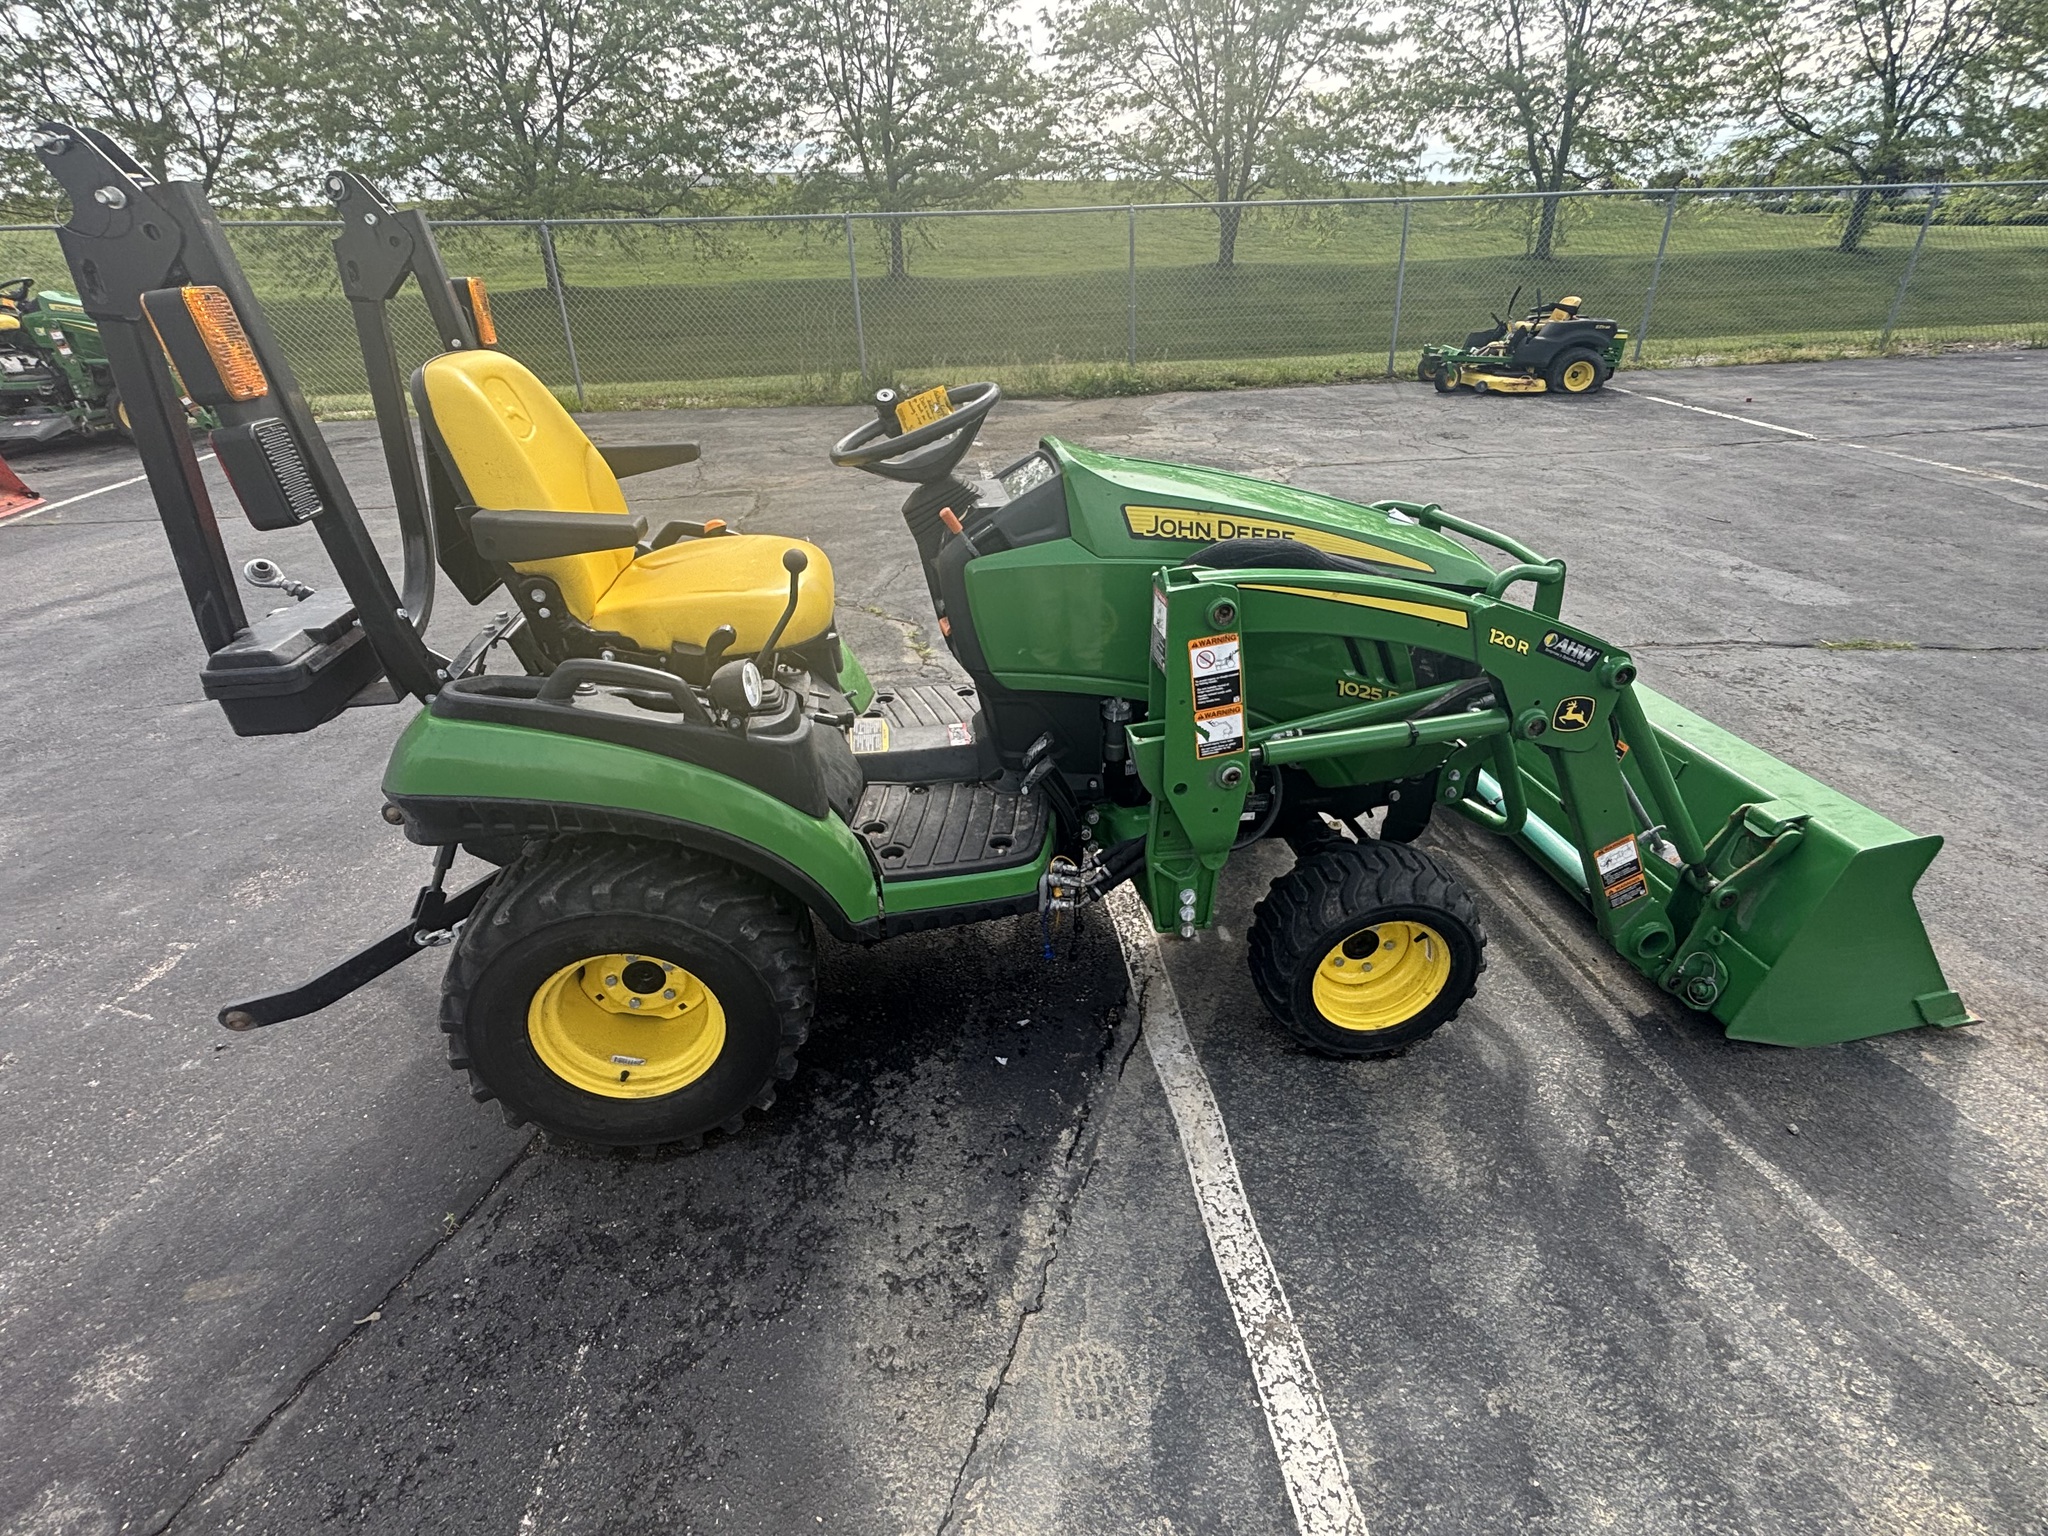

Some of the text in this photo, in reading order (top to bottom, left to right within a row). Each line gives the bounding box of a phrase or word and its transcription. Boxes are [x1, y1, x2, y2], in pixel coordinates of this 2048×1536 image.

[1146, 515, 1211, 538] JOHN
[1199, 634, 1237, 646] WARNING
[1489, 627, 1530, 655] 120 R
[1553, 638, 1598, 663] AHW
[1338, 679, 1383, 700] 1025
[1203, 706, 1241, 719] WARNING
